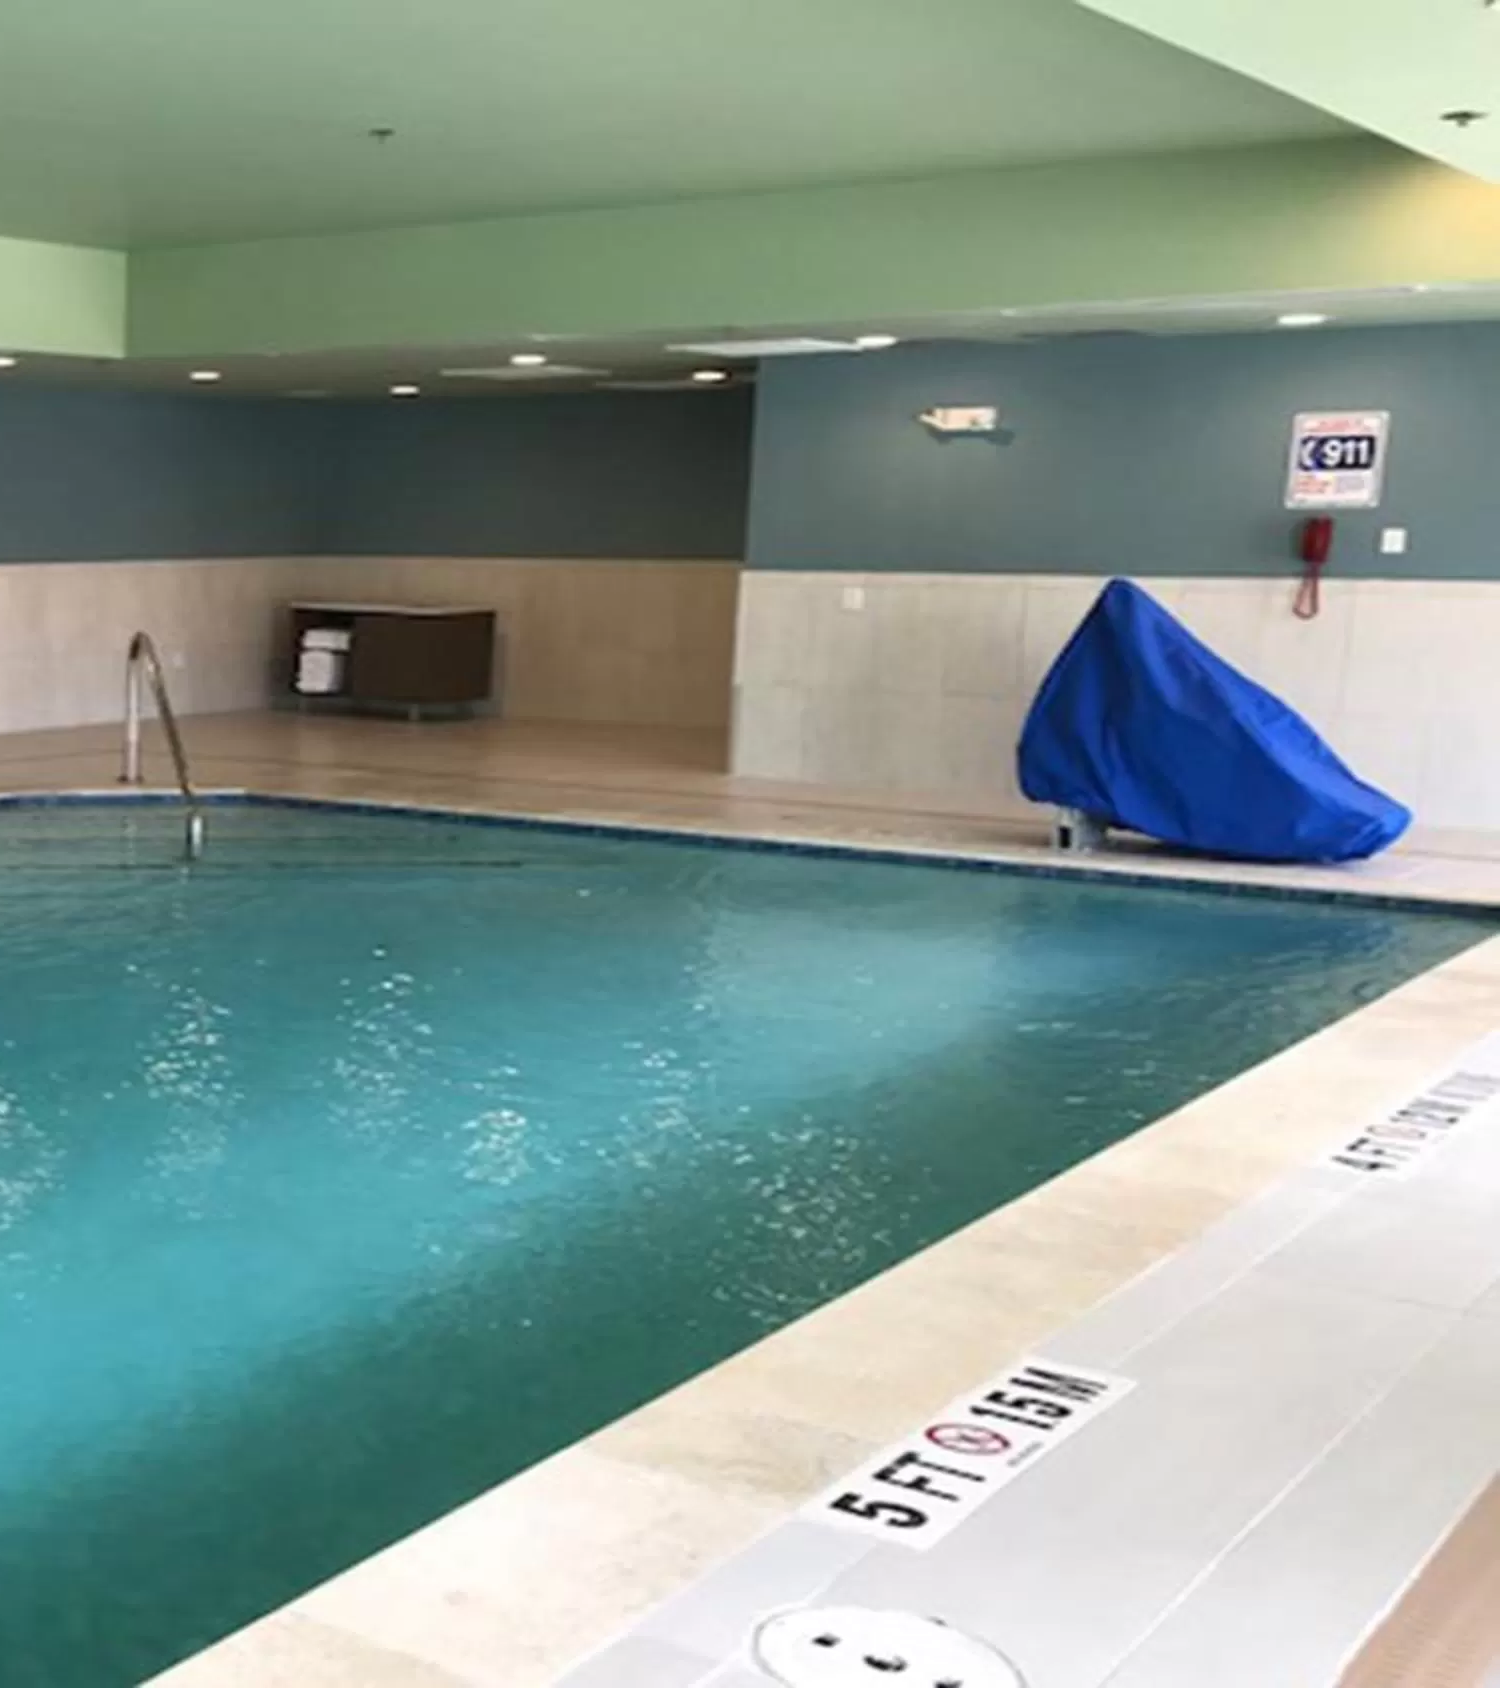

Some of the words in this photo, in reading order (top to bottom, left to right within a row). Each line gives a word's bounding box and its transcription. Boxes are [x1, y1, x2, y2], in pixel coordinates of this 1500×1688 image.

[1322, 438, 1370, 467] 911
[872, 1450, 987, 1502] FT
[829, 1491, 931, 1529] 5
